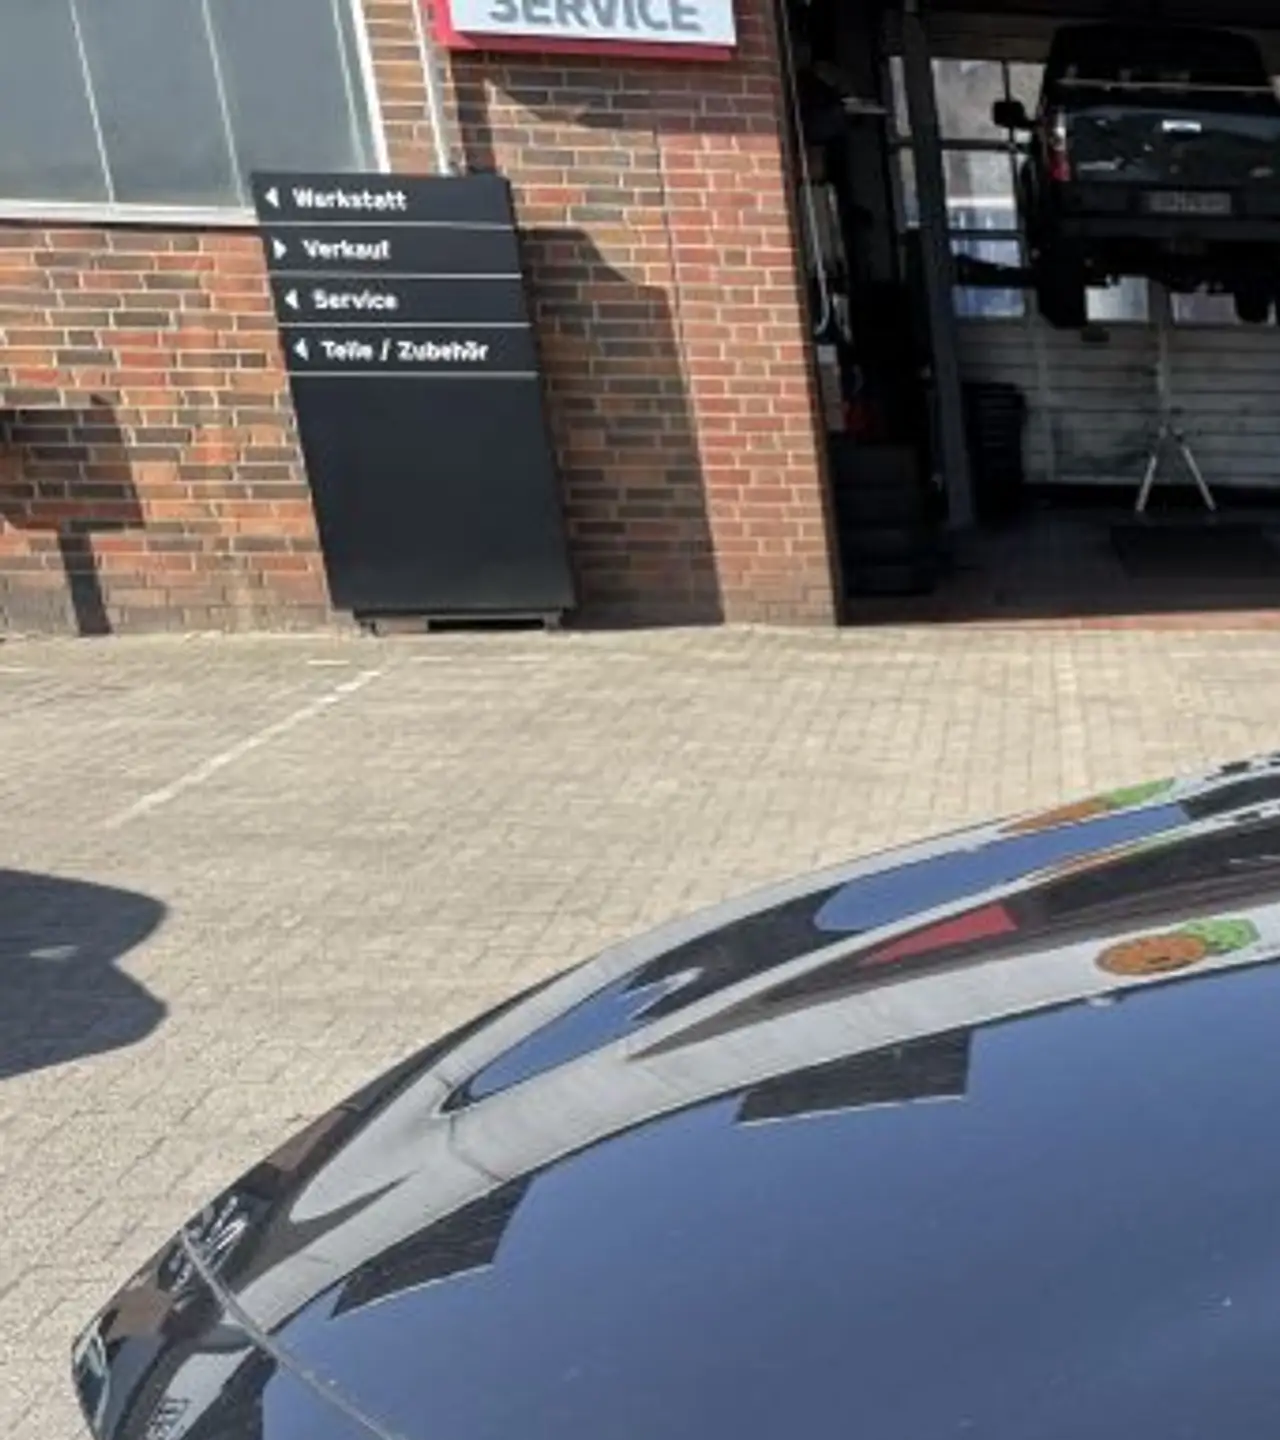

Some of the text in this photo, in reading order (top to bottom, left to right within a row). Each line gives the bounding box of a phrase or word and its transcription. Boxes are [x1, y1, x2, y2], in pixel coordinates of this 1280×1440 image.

[489, 0, 703, 32] SERVICE
[292, 187, 408, 211] Werkstatt
[301, 239, 391, 260] Verkauf
[312, 289, 398, 310] Service
[320, 338, 489, 362] Teile / Zubehör
